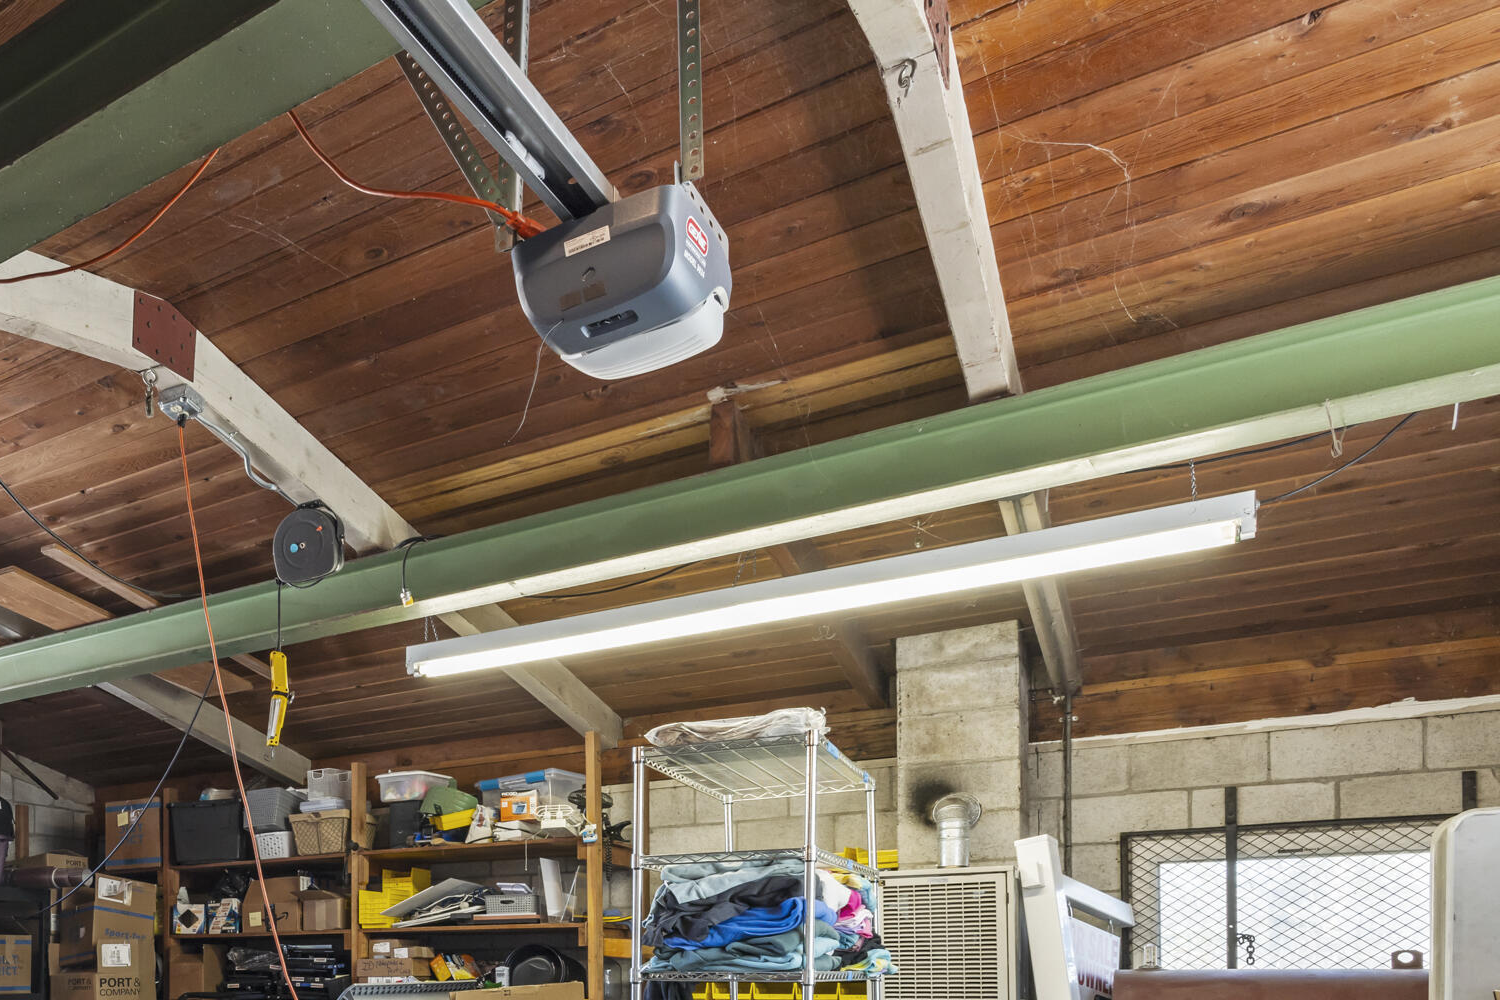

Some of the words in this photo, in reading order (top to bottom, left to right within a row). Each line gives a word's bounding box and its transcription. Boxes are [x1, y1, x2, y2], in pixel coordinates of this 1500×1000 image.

[100, 977, 132, 988] PORT
[134, 977, 141, 987] &
[100, 988, 141, 998] COMPANY
